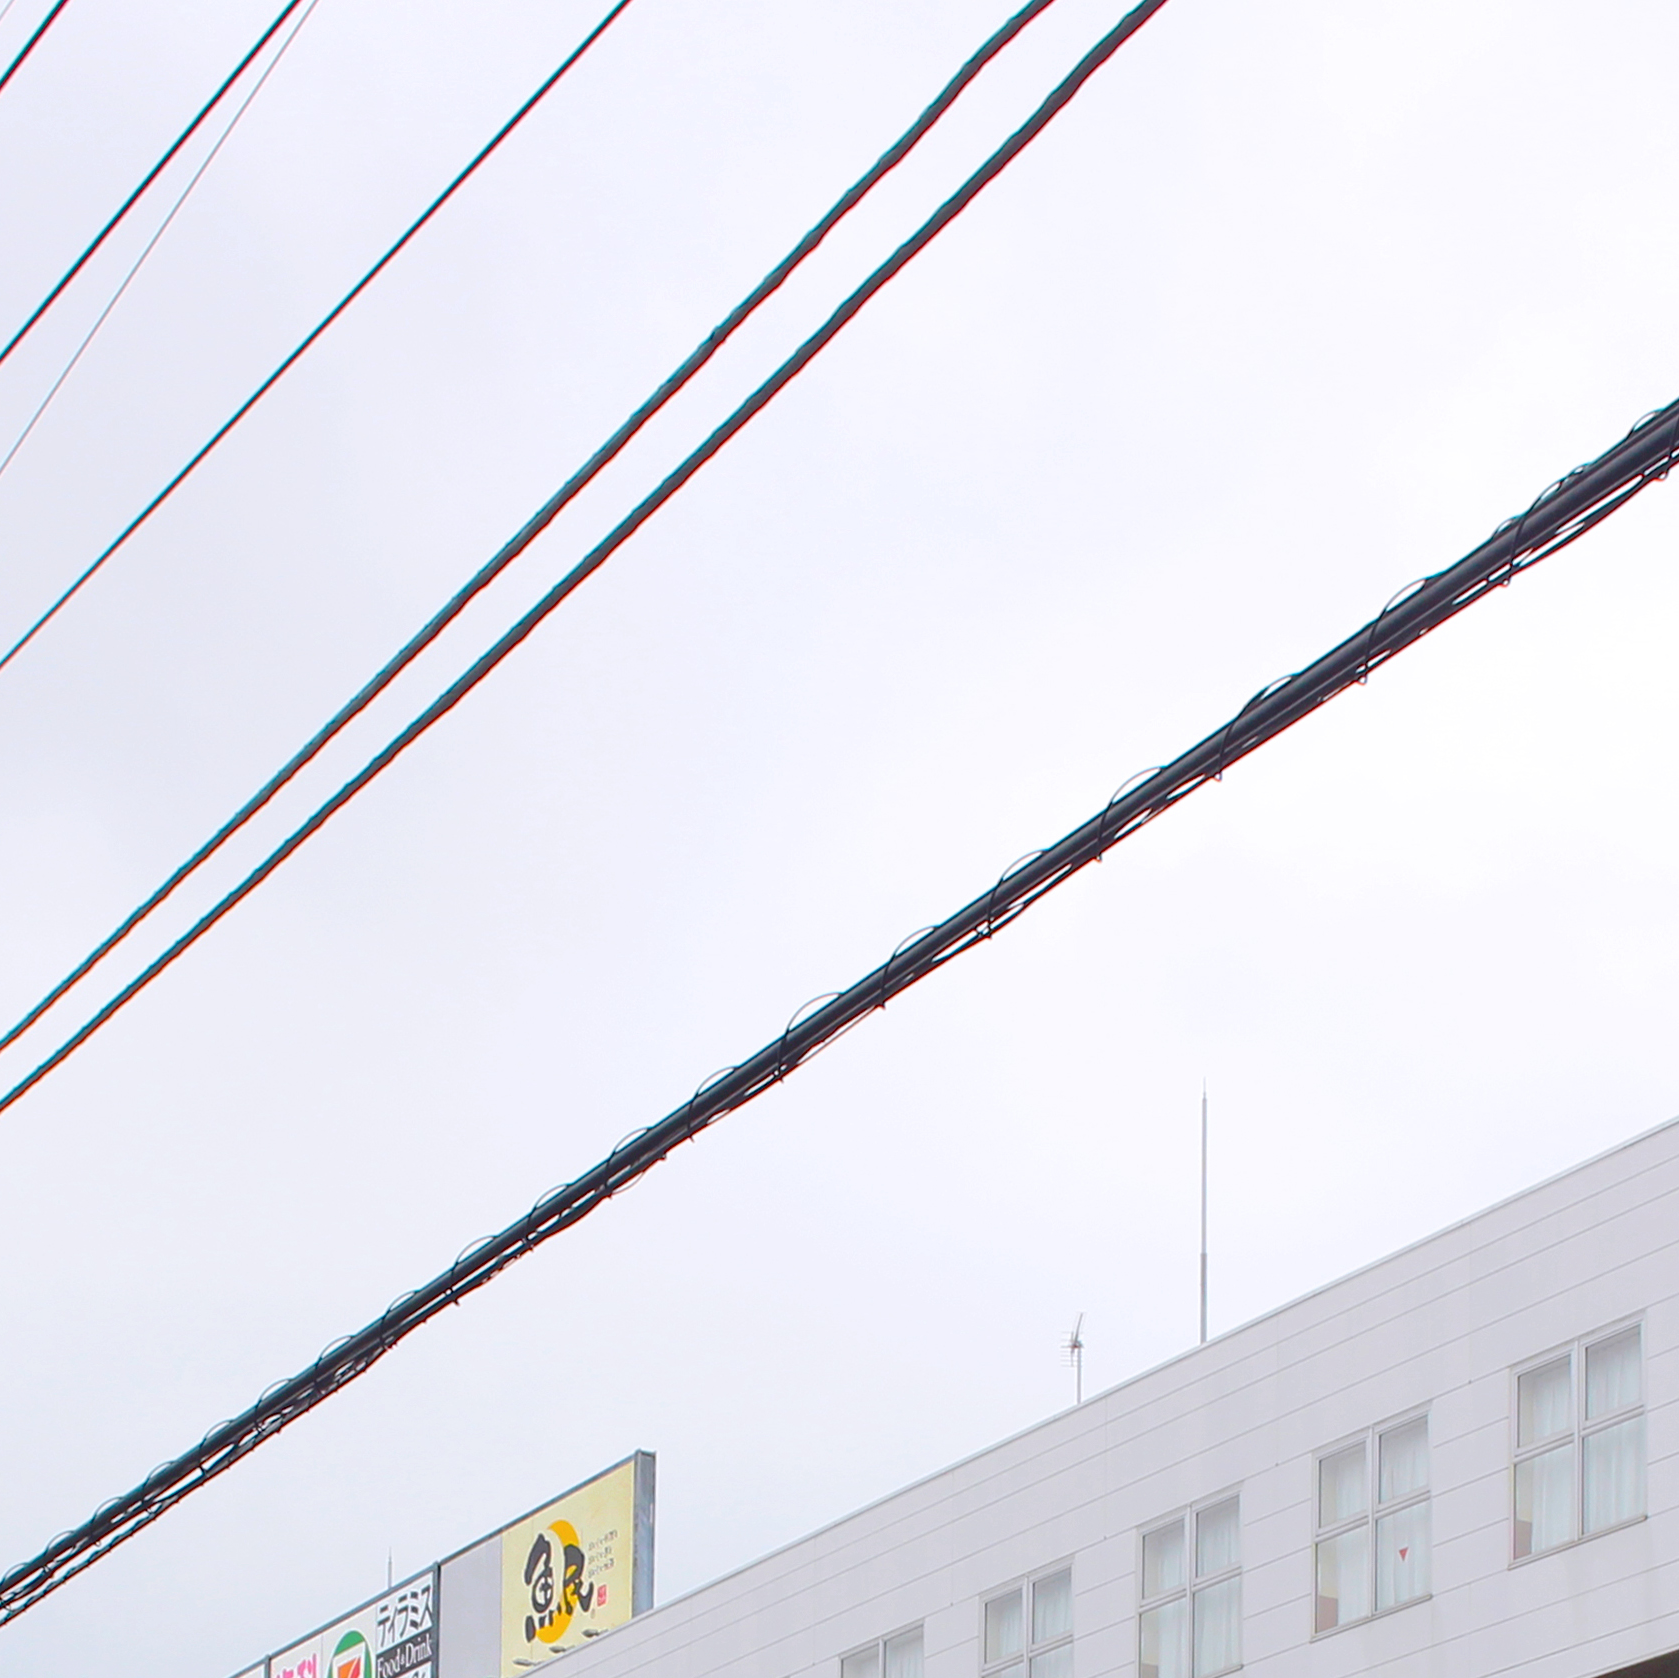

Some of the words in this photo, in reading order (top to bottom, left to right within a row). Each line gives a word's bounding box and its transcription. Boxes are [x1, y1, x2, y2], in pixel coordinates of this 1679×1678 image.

[377, 1585, 433, 1648] ティラミス
